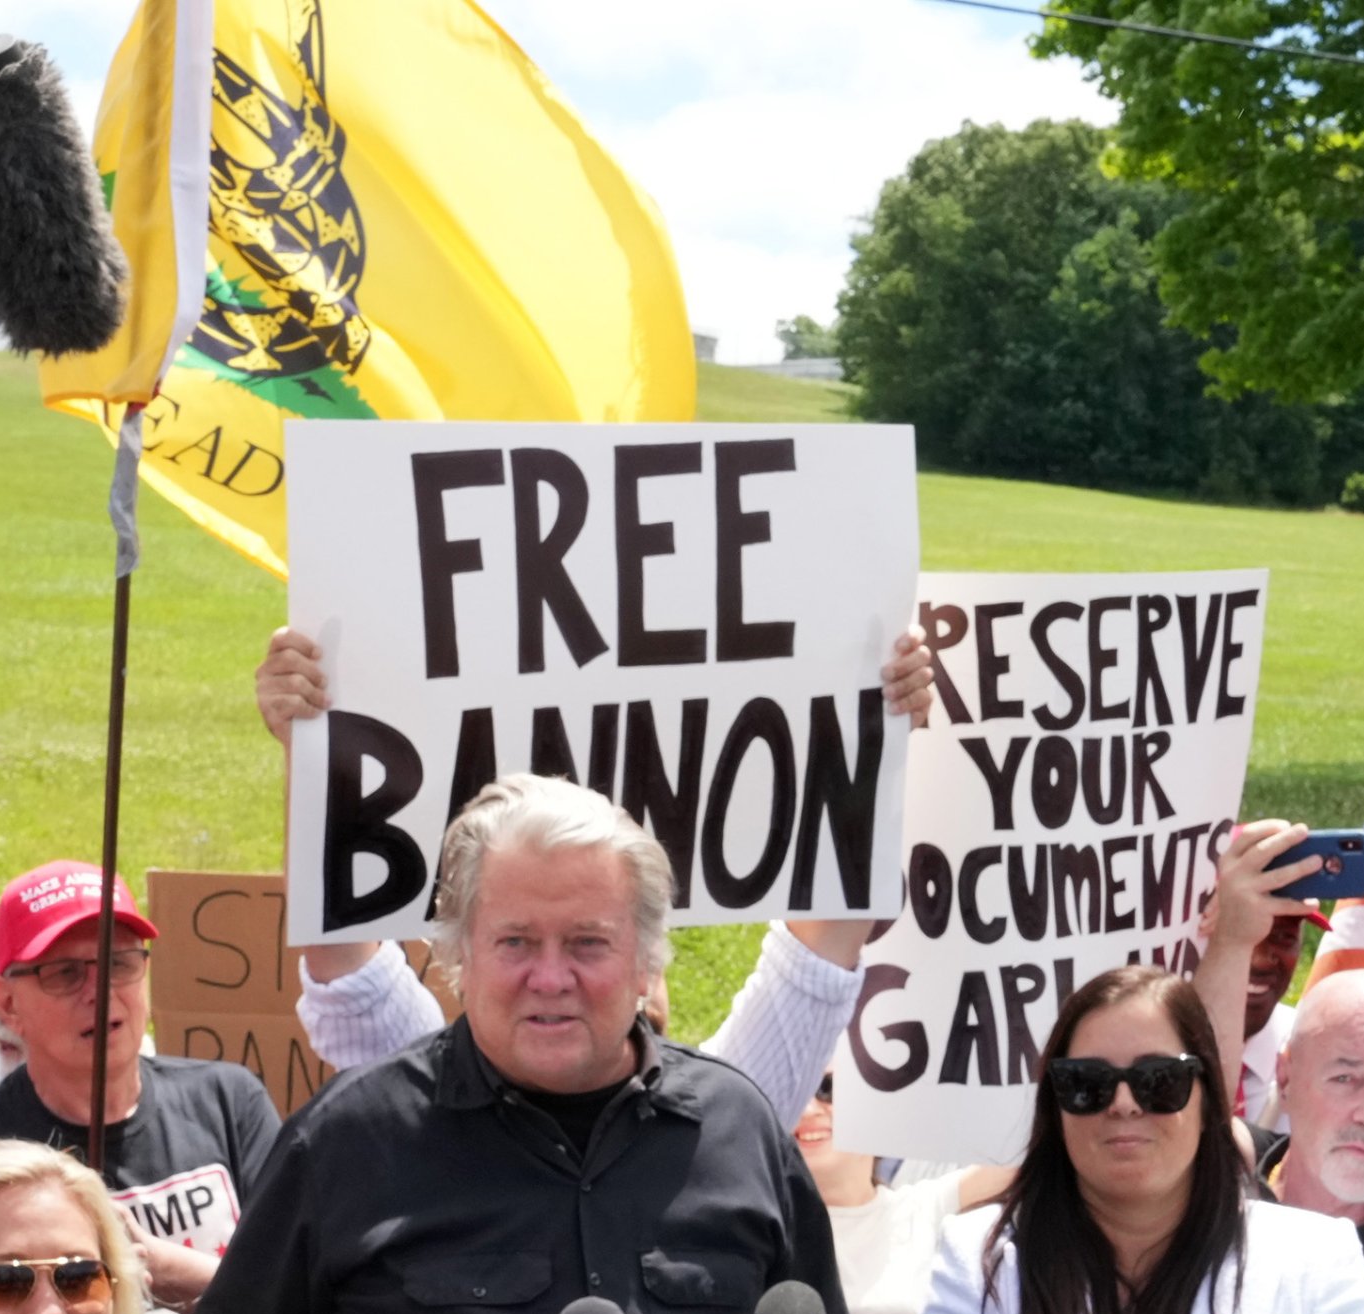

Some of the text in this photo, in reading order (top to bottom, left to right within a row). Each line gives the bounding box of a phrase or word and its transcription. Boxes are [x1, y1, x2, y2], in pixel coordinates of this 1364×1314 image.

[410, 437, 797, 680] FREE
[958, 730, 1177, 831] YOUR
[29, 886, 76, 913] GREAT
